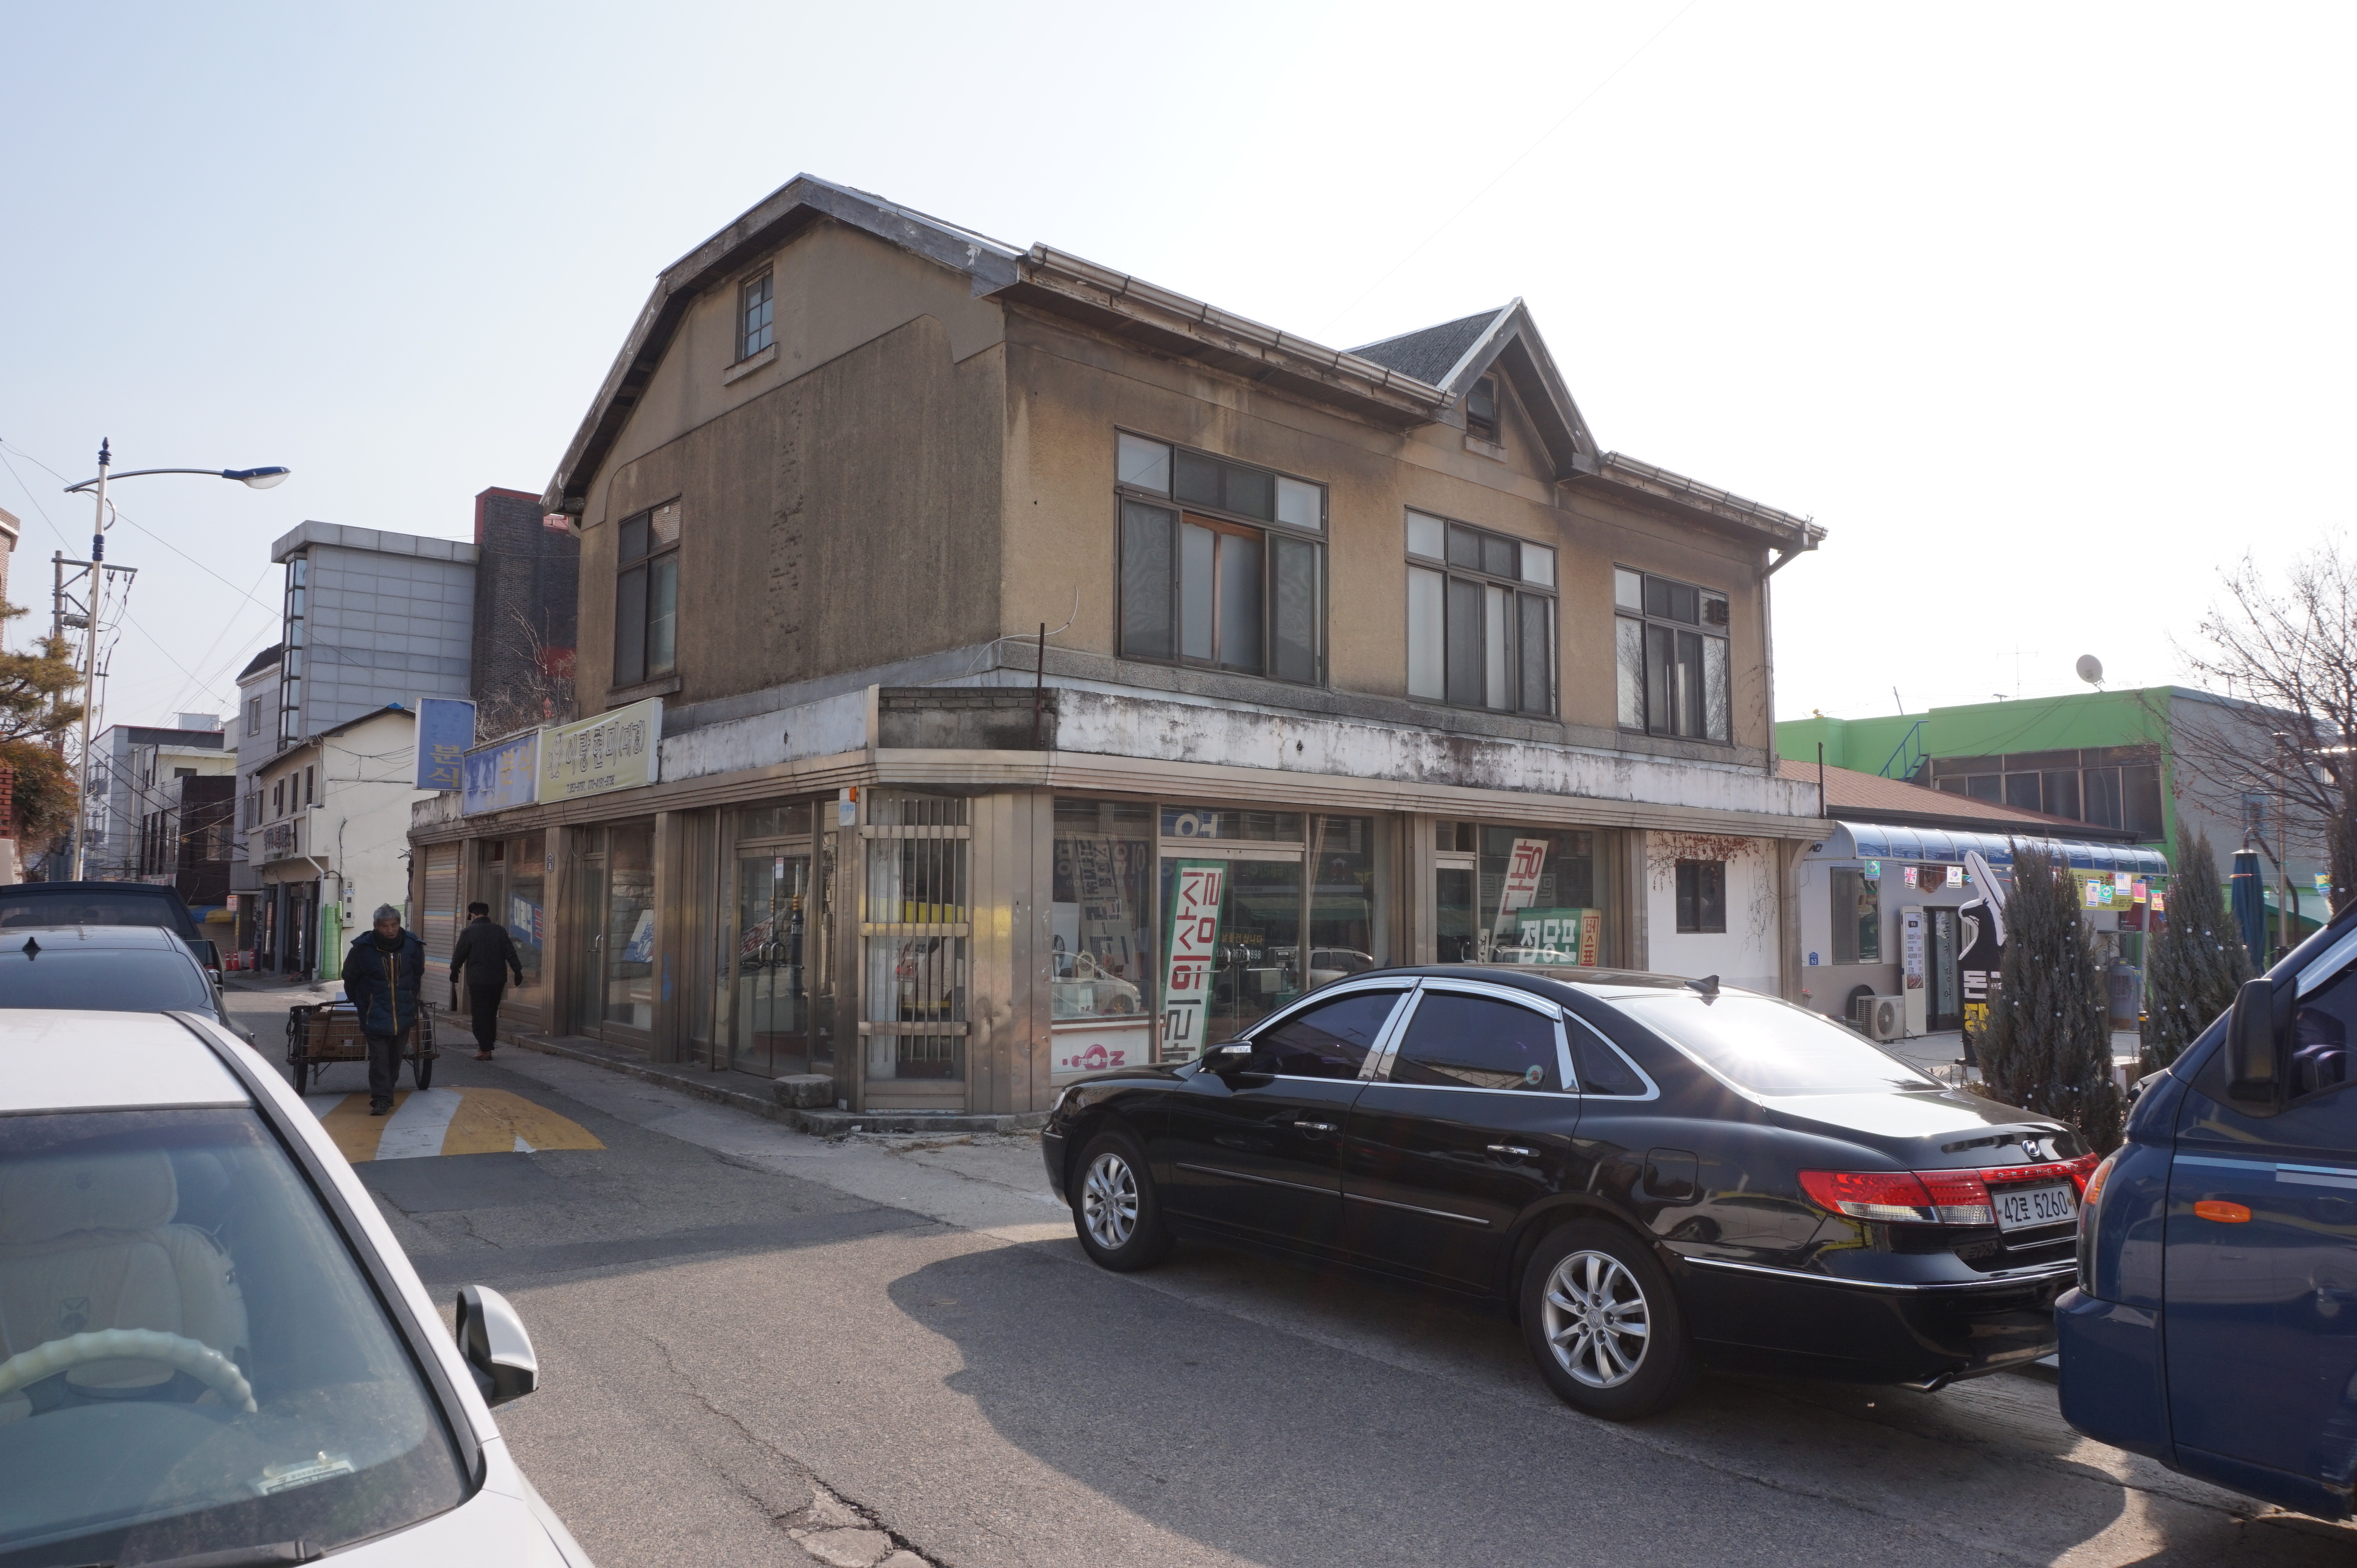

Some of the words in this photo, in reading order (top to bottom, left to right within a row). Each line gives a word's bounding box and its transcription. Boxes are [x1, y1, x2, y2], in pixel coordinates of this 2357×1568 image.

[427, 744, 464, 788] 분식
[499, 741, 535, 786] 분식
[1170, 871, 1223, 990] 의상실
[1242, 933, 1263, 945] 삽니다
[1518, 919, 1577, 964] 전당포
[1583, 919, 1595, 963] 버스표
[1998, 1163, 2079, 1178] GRANDEUR
[2004, 1195, 2031, 1223] 42로
[2033, 1191, 2068, 1219] 5260
